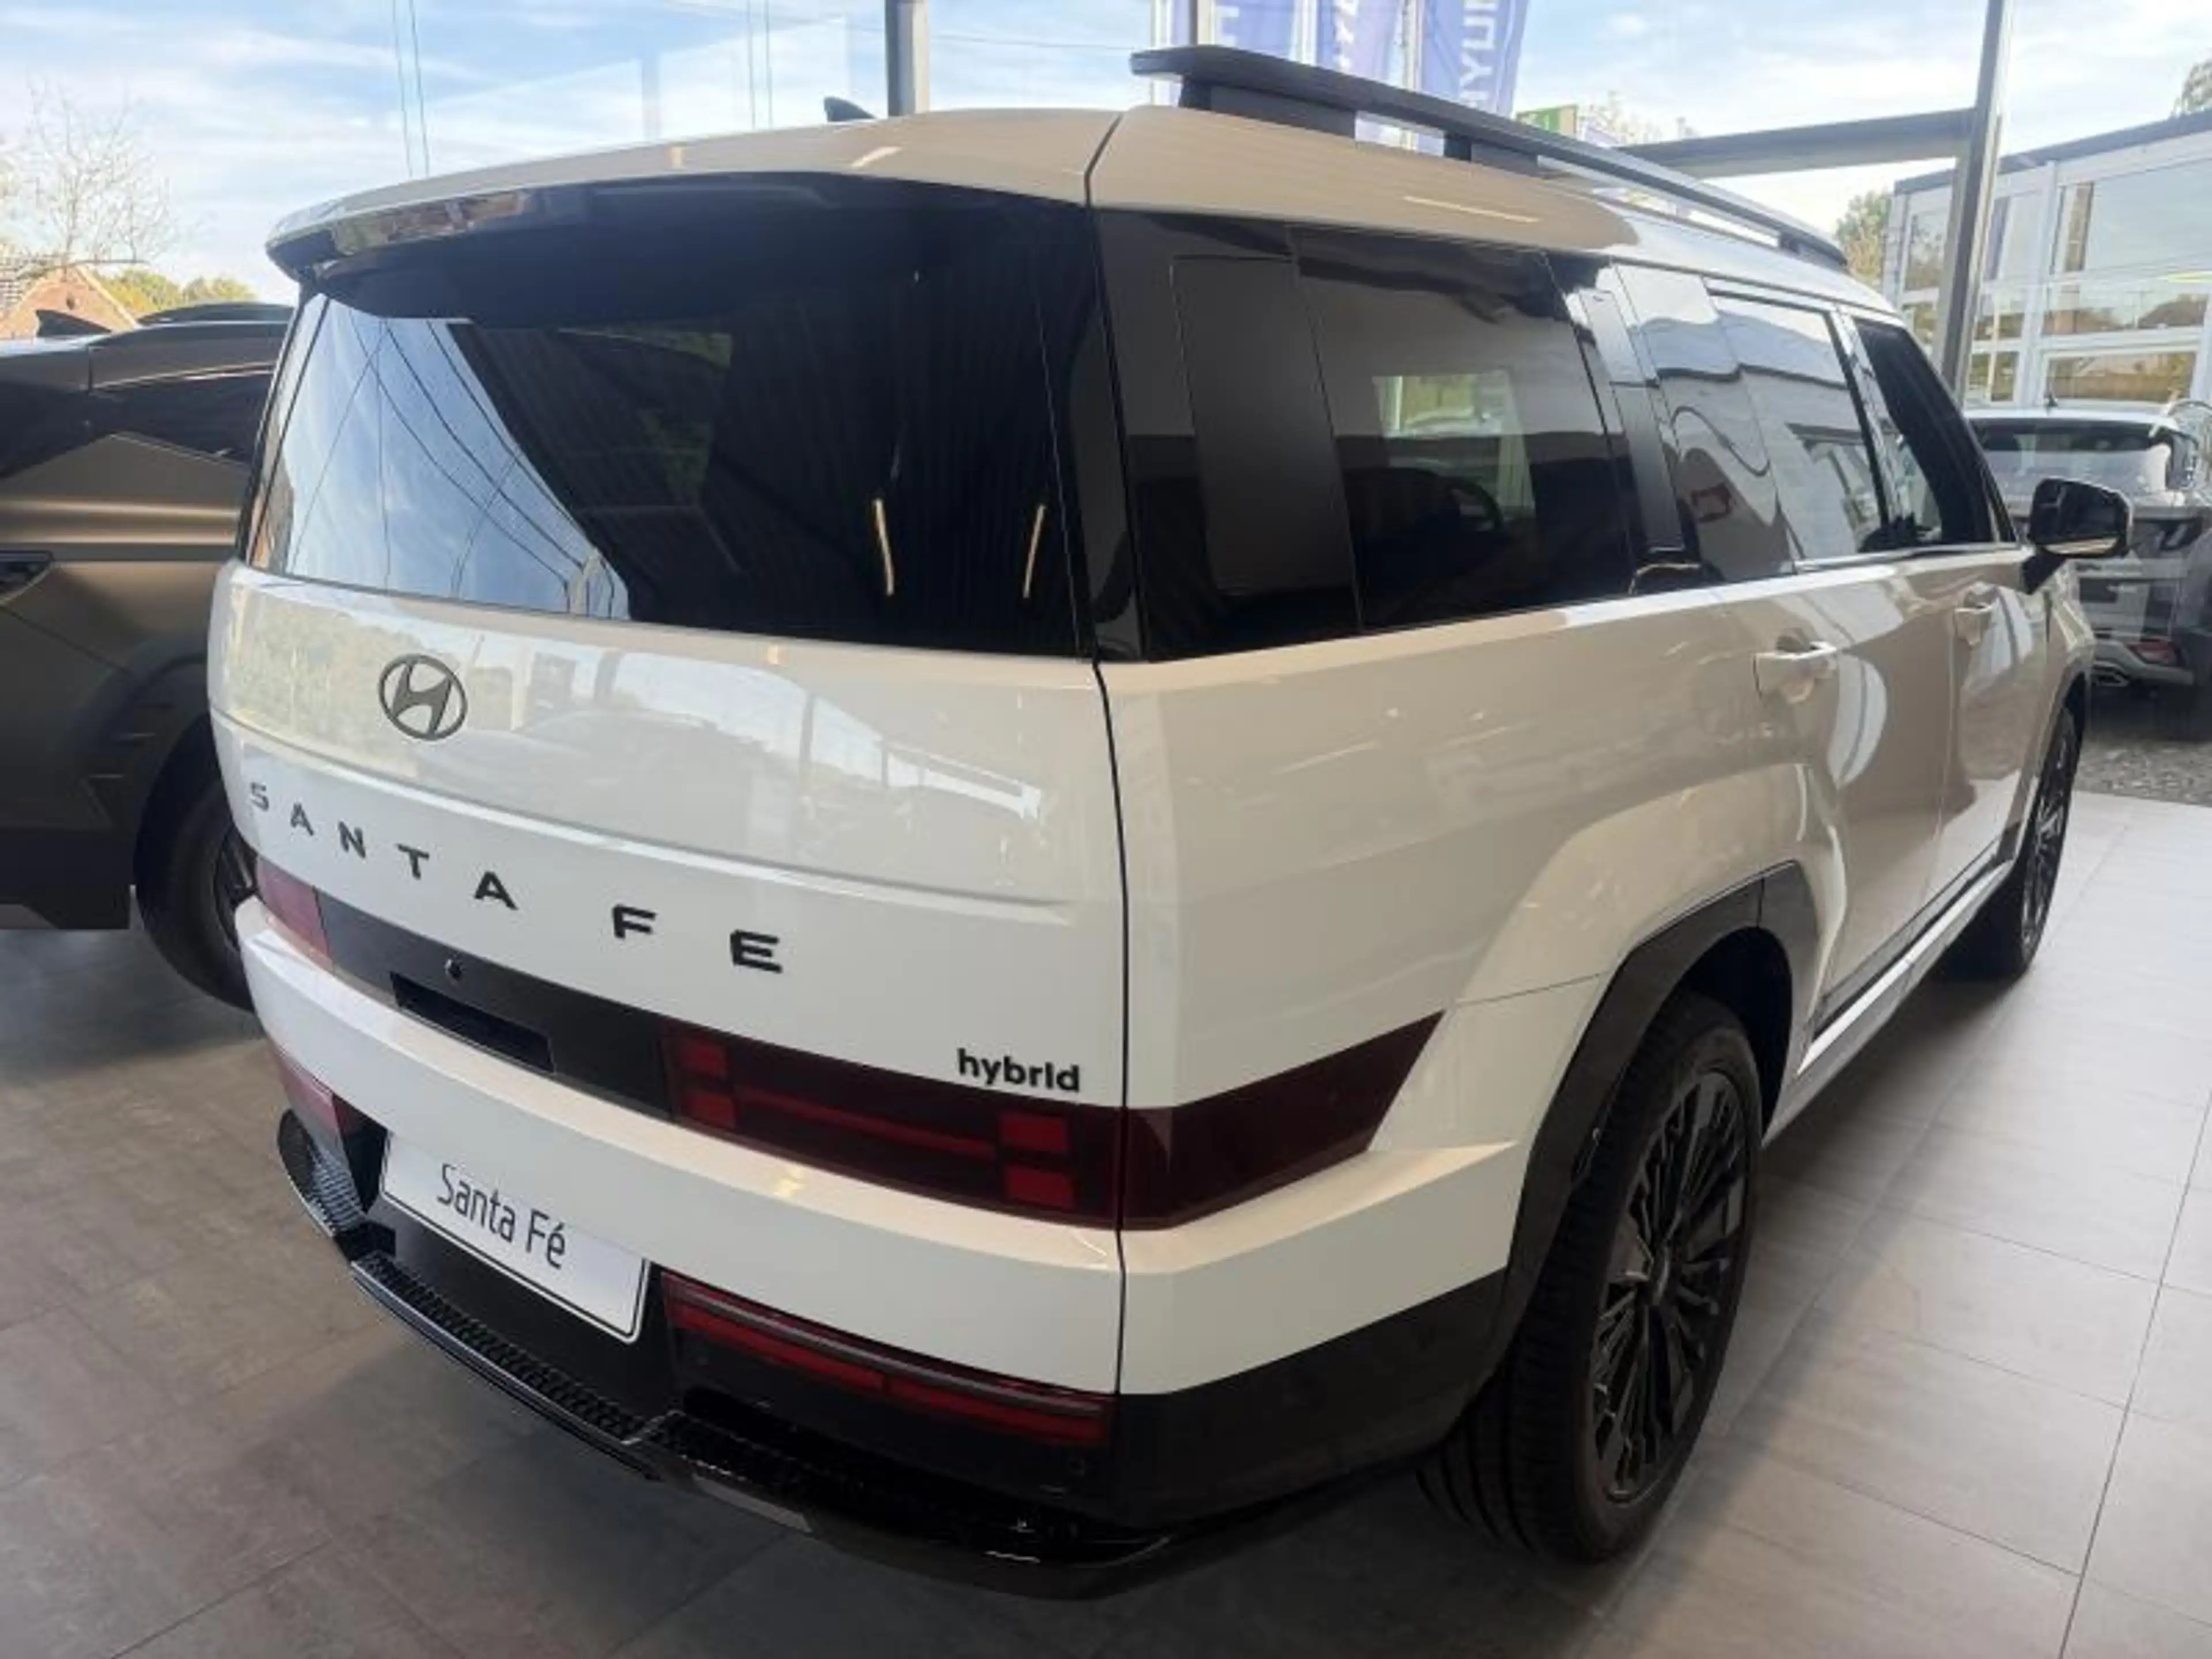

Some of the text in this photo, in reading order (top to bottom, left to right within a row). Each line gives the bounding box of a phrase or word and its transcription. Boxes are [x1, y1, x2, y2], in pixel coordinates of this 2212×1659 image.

[249, 781, 783, 974] SANTA FE
[957, 1047, 1080, 1093] hybrid
[437, 1163, 566, 1270] Santa Fé
